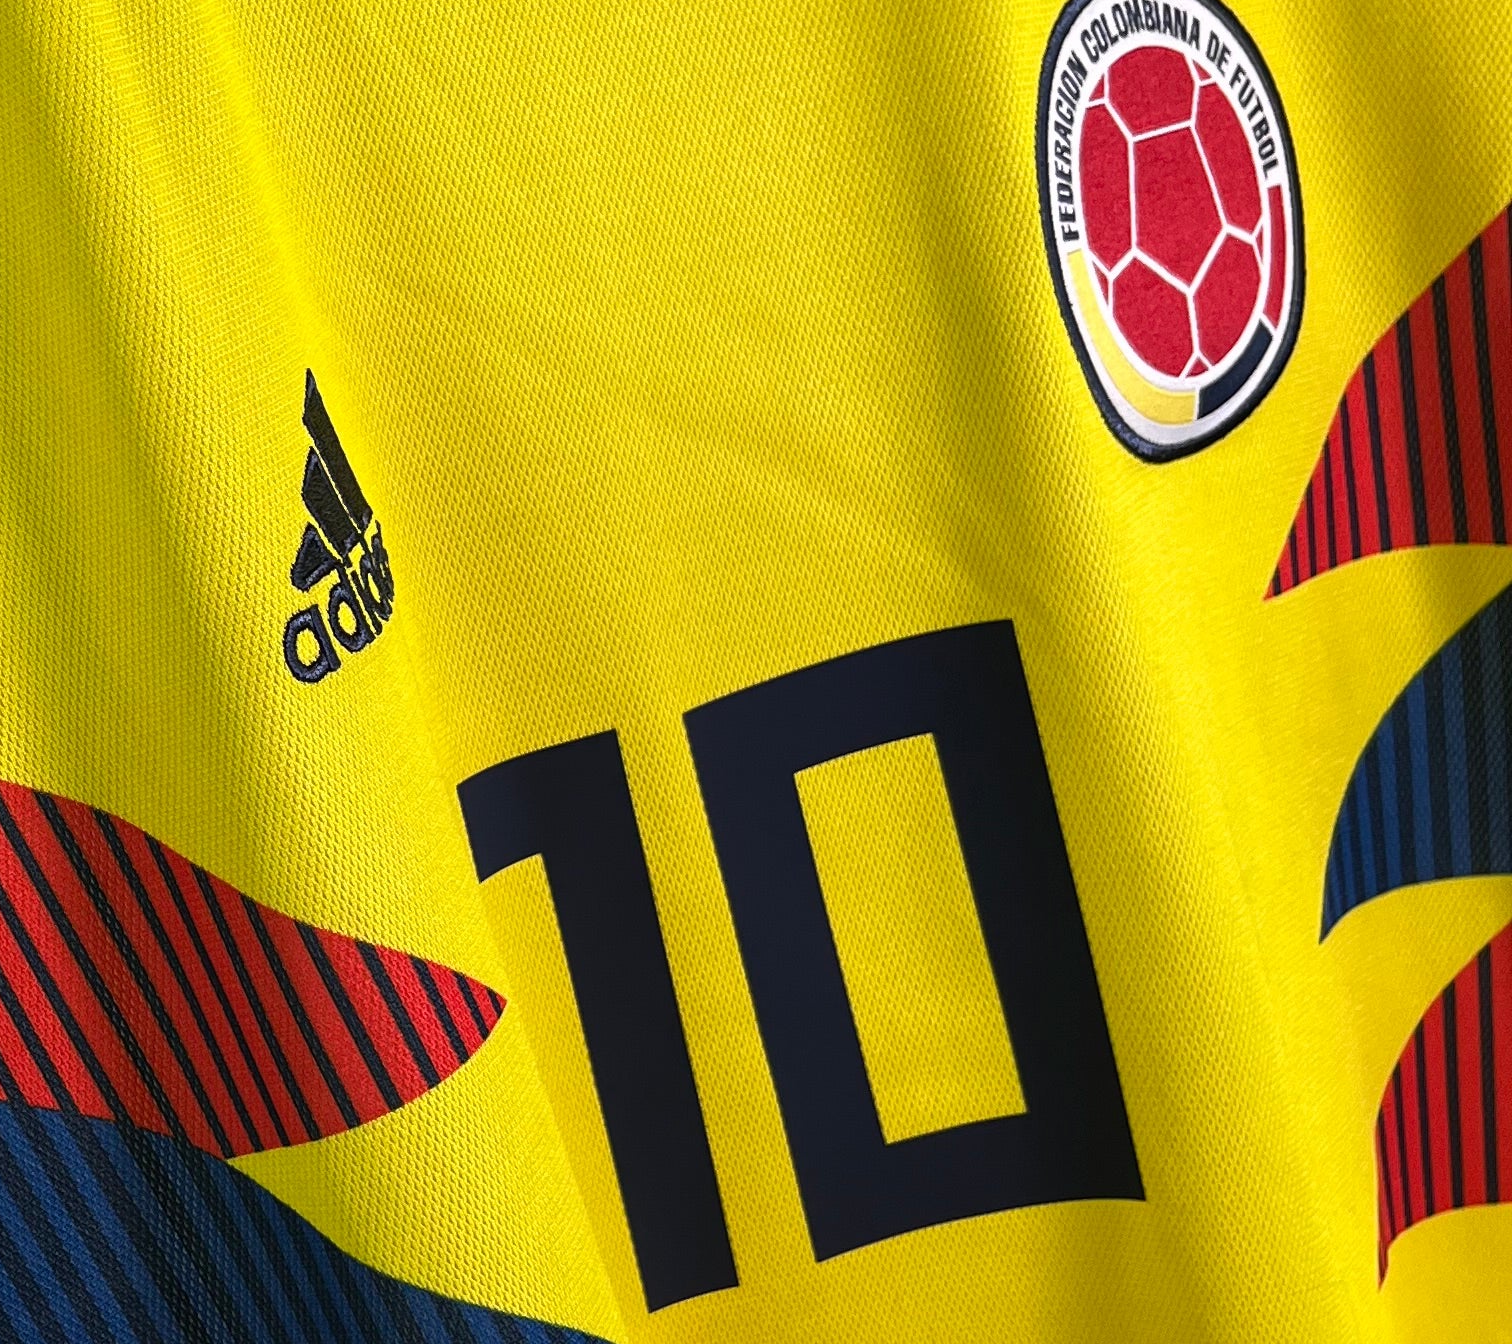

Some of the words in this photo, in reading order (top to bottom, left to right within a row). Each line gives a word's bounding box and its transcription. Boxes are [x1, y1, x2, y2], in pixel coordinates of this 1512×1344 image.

[1054, 50, 1088, 242] FEDERACION
[1206, 30, 1232, 77] DE
[1229, 63, 1279, 181] FUTBOL
[456, 619, 1146, 1314] 10
